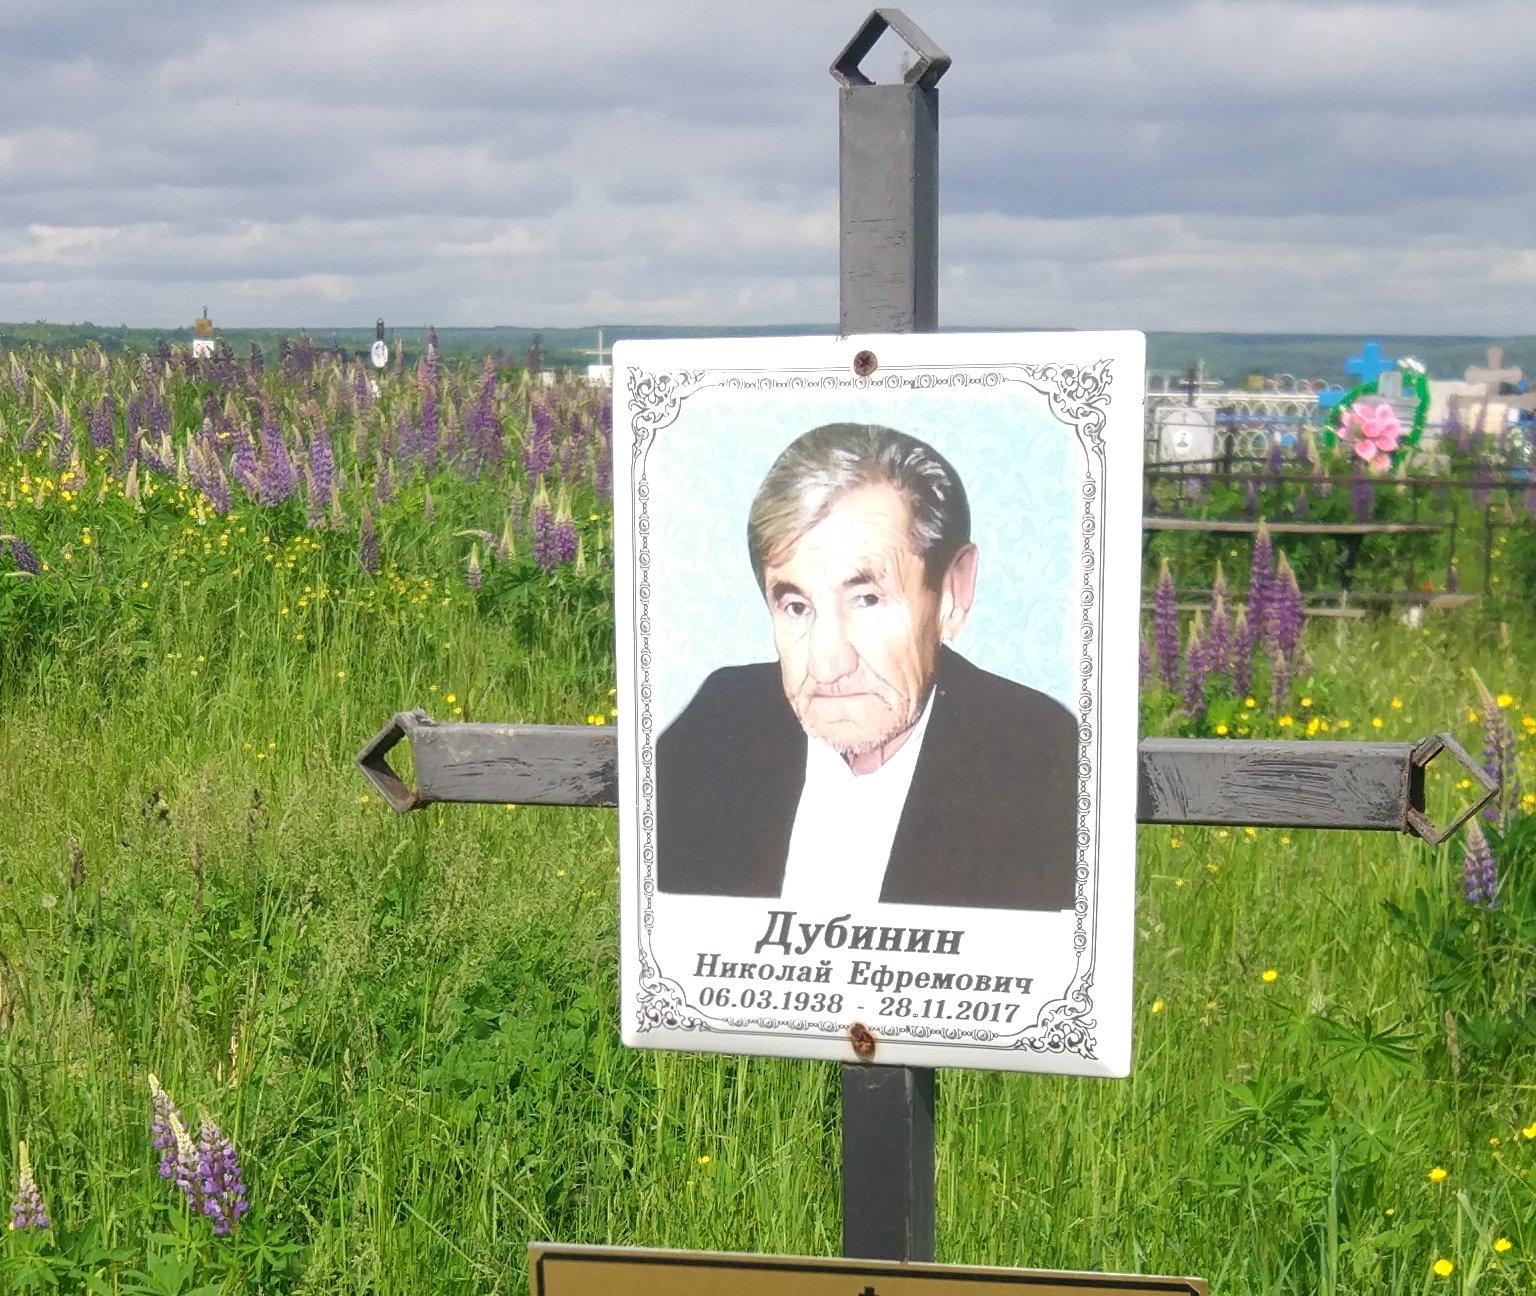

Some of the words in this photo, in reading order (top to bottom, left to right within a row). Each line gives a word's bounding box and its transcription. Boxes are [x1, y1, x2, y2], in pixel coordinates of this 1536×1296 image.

[754, 910, 965, 956] Дубинин
[692, 952, 833, 985] Николай
[847, 959, 1034, 995] Ефремович
[698, 986, 844, 1014] 06.03.1938
[878, 996, 1021, 1024] 28.11.2017
